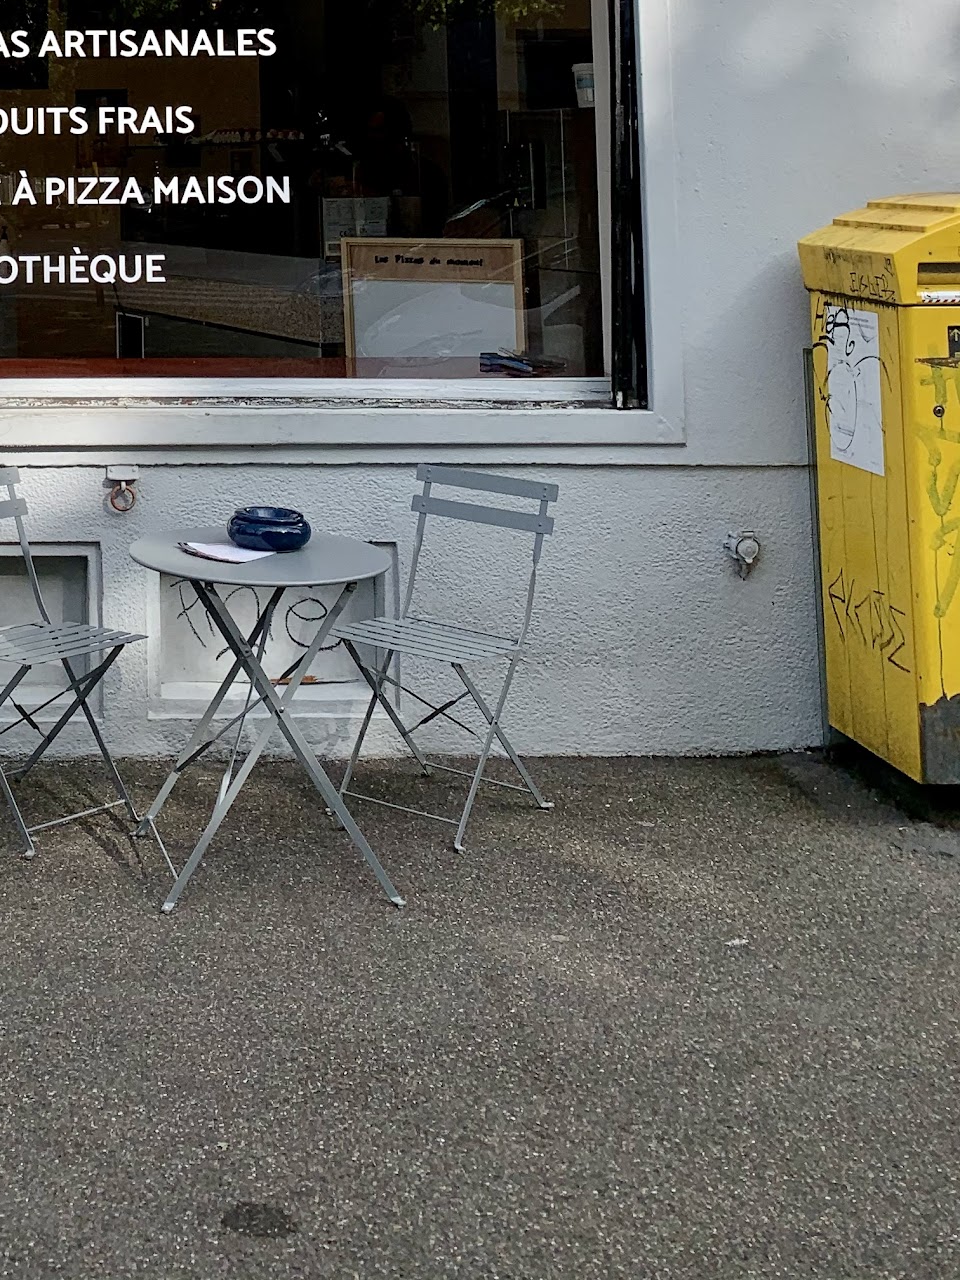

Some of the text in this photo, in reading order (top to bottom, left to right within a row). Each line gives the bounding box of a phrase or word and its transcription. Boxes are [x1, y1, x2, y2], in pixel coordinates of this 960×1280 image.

[38, 29, 276, 57] ARTISANALES
[99, 106, 194, 133] FRAIS
[12, 171, 36, 205] À
[46, 177, 144, 204] PIZZA
[154, 176, 290, 203] MAISON
